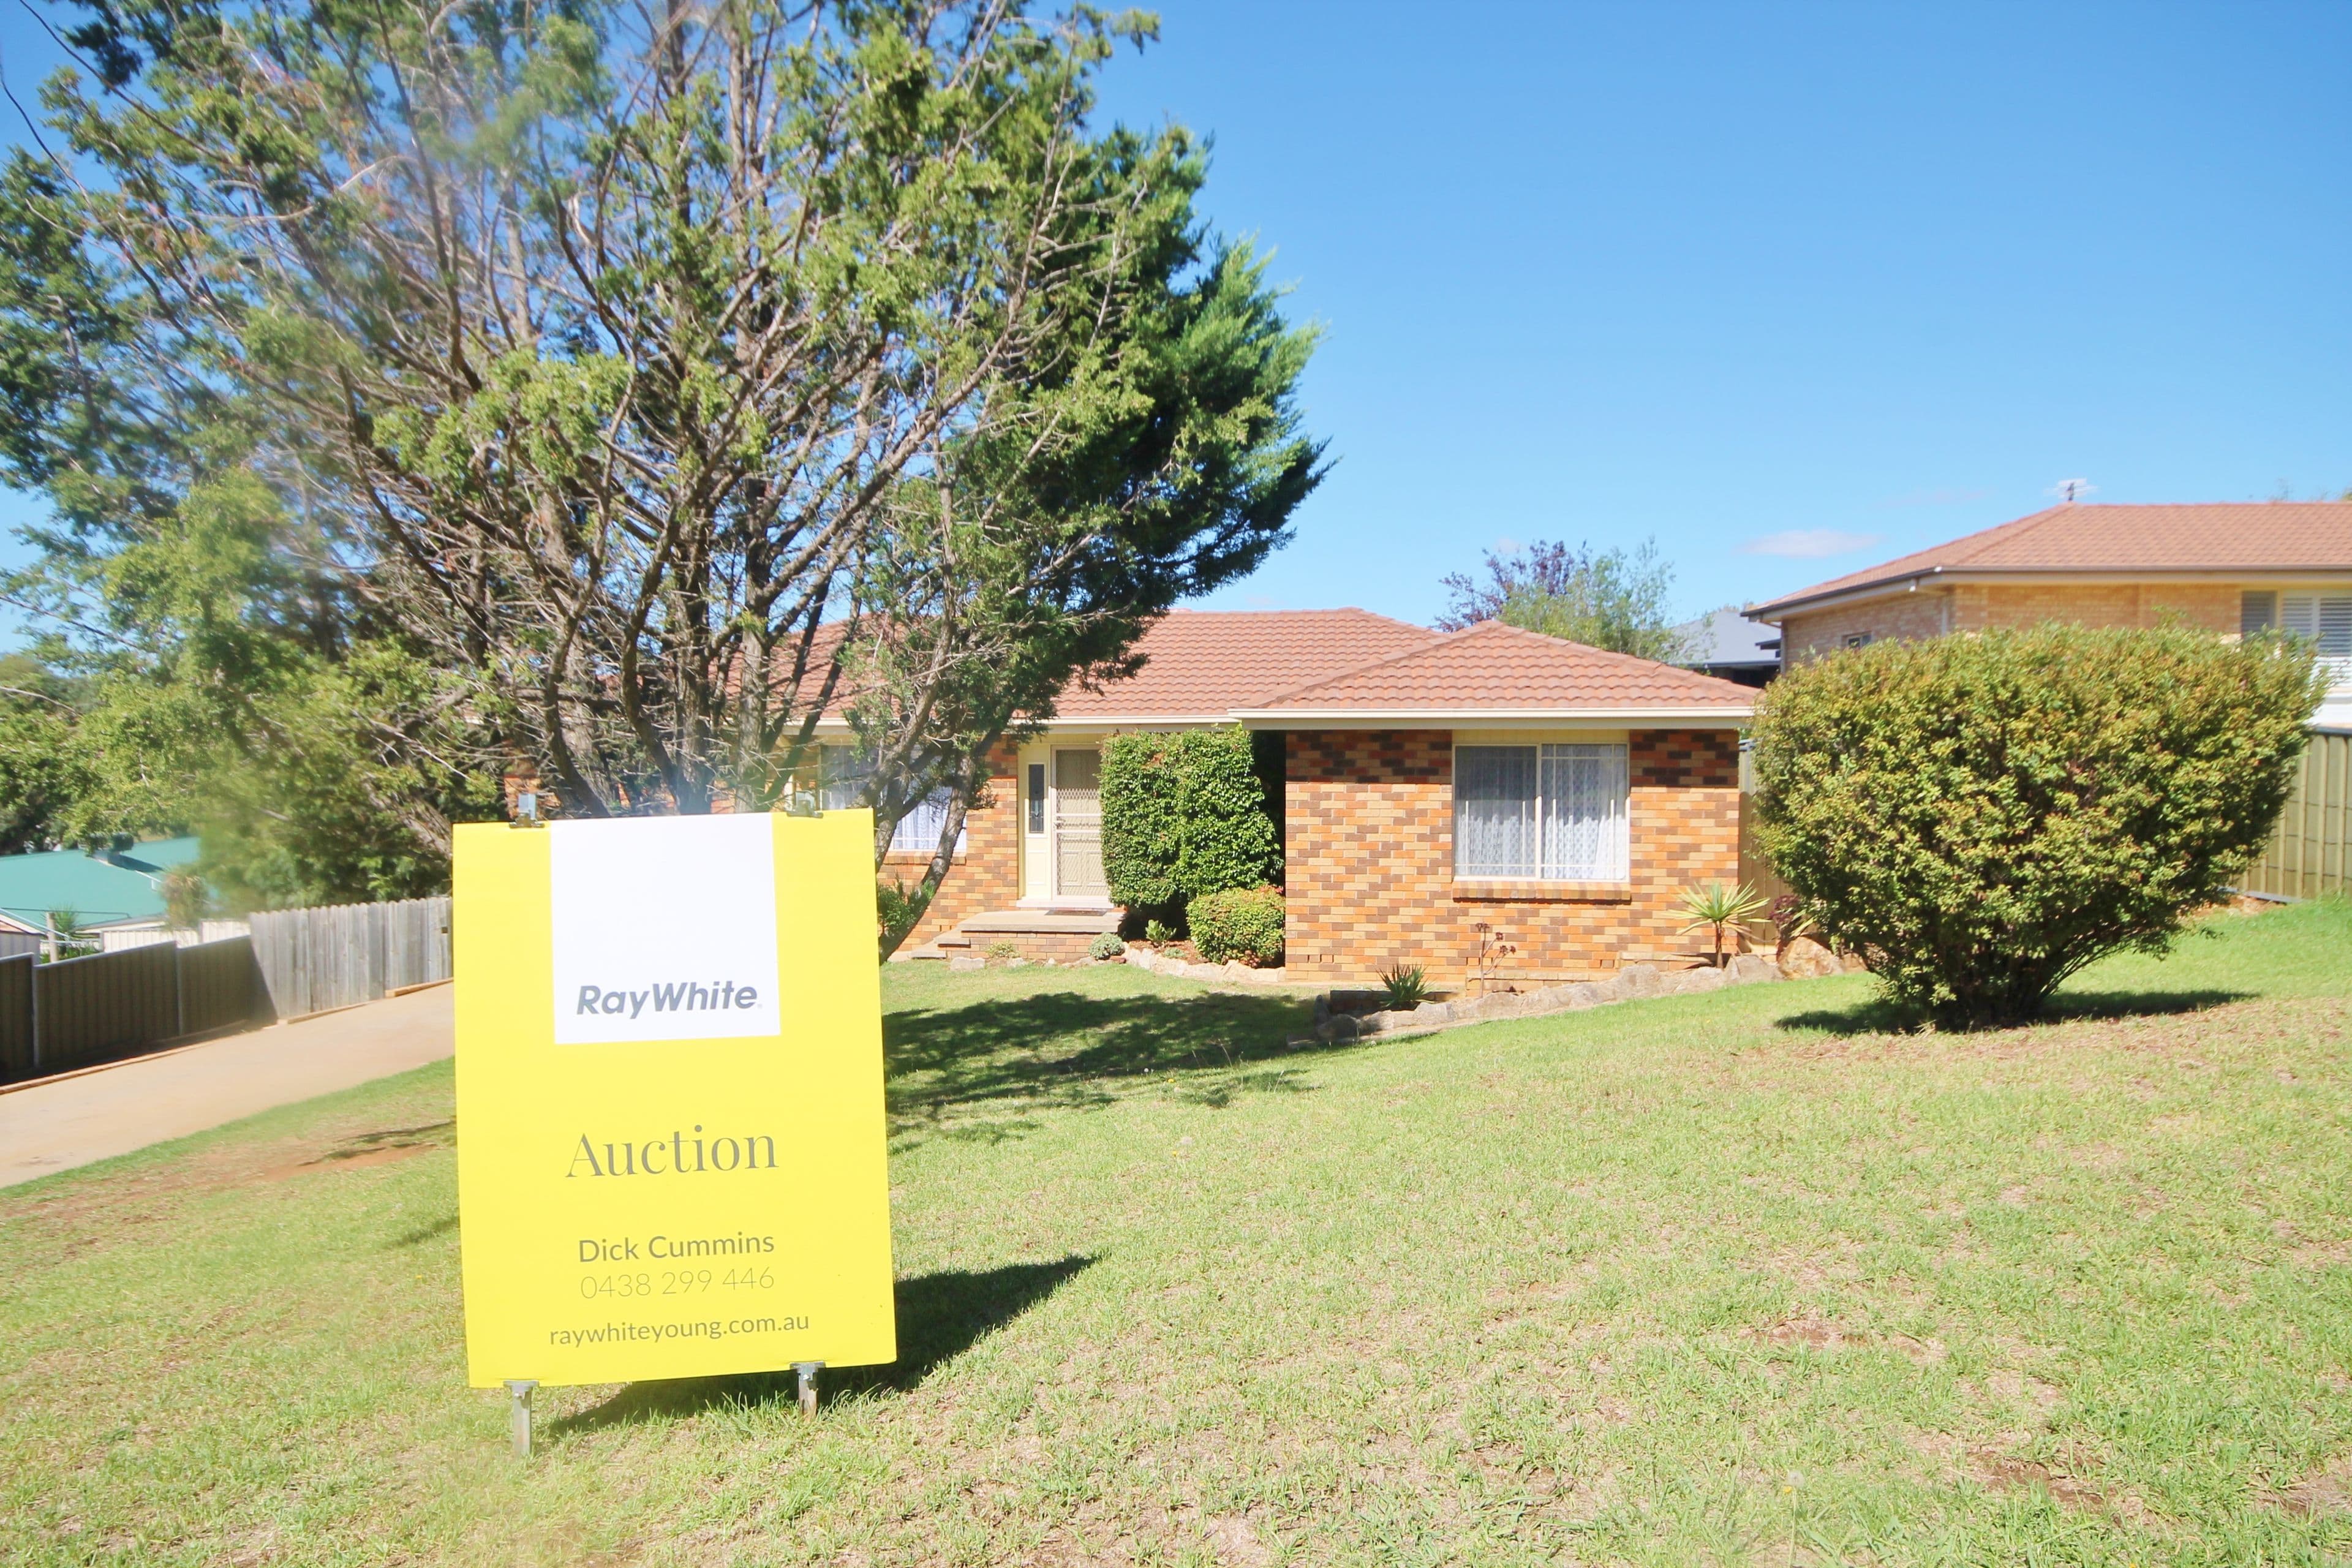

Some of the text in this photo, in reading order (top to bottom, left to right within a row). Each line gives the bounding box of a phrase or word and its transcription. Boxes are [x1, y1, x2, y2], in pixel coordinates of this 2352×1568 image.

[565, 1125, 779, 1177] Auction
[579, 1231, 774, 1262] Dick Cummins
[581, 1267, 774, 1299] 0438 299 446
[550, 1316, 809, 1348] raywhiteyoung.com.au
